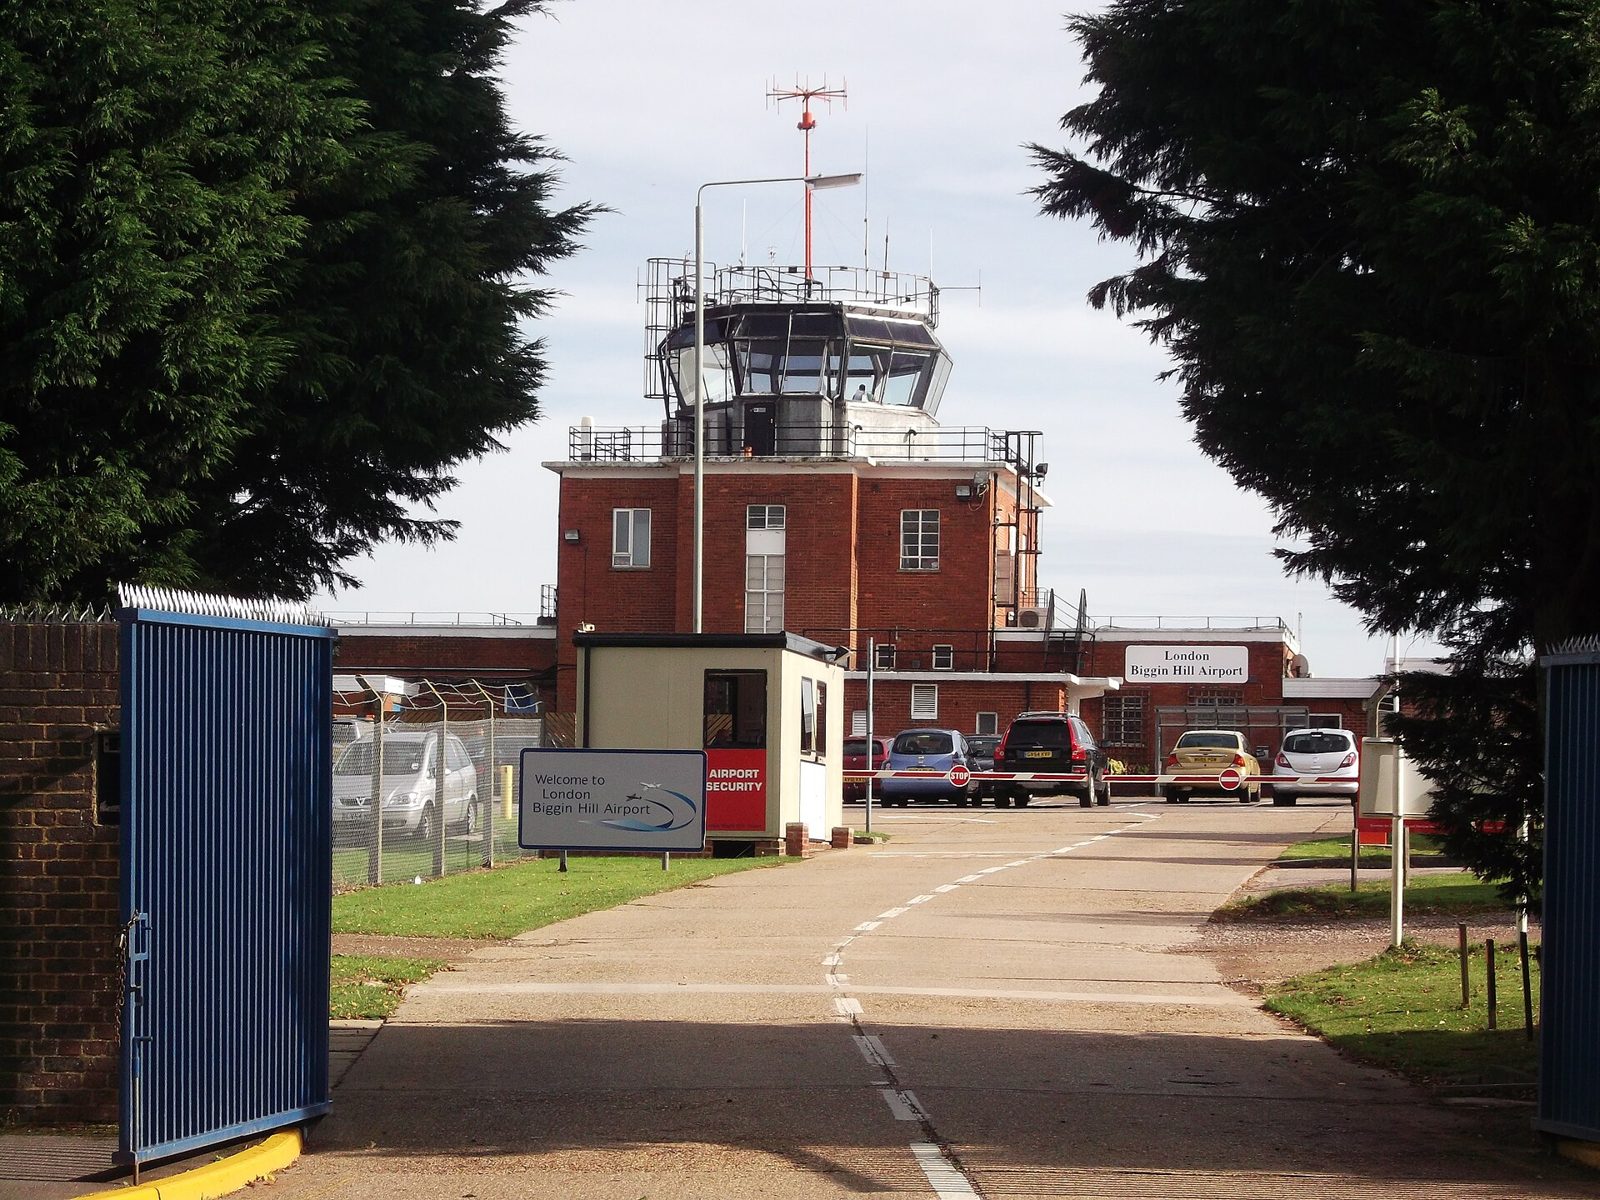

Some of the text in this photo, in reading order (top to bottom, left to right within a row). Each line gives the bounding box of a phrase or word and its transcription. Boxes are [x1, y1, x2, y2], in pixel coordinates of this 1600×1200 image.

[1165, 651, 1210, 661] London
[1131, 665, 1243, 678] Biggin Hill Airport
[709, 769, 760, 779] AIRPORT
[951, 771, 969, 780] STOP
[535, 774, 605, 786] Welcome to
[706, 782, 763, 791] SECURITY
[542, 789, 591, 800] London
[533, 802, 651, 817] Biggin Hill Airport
